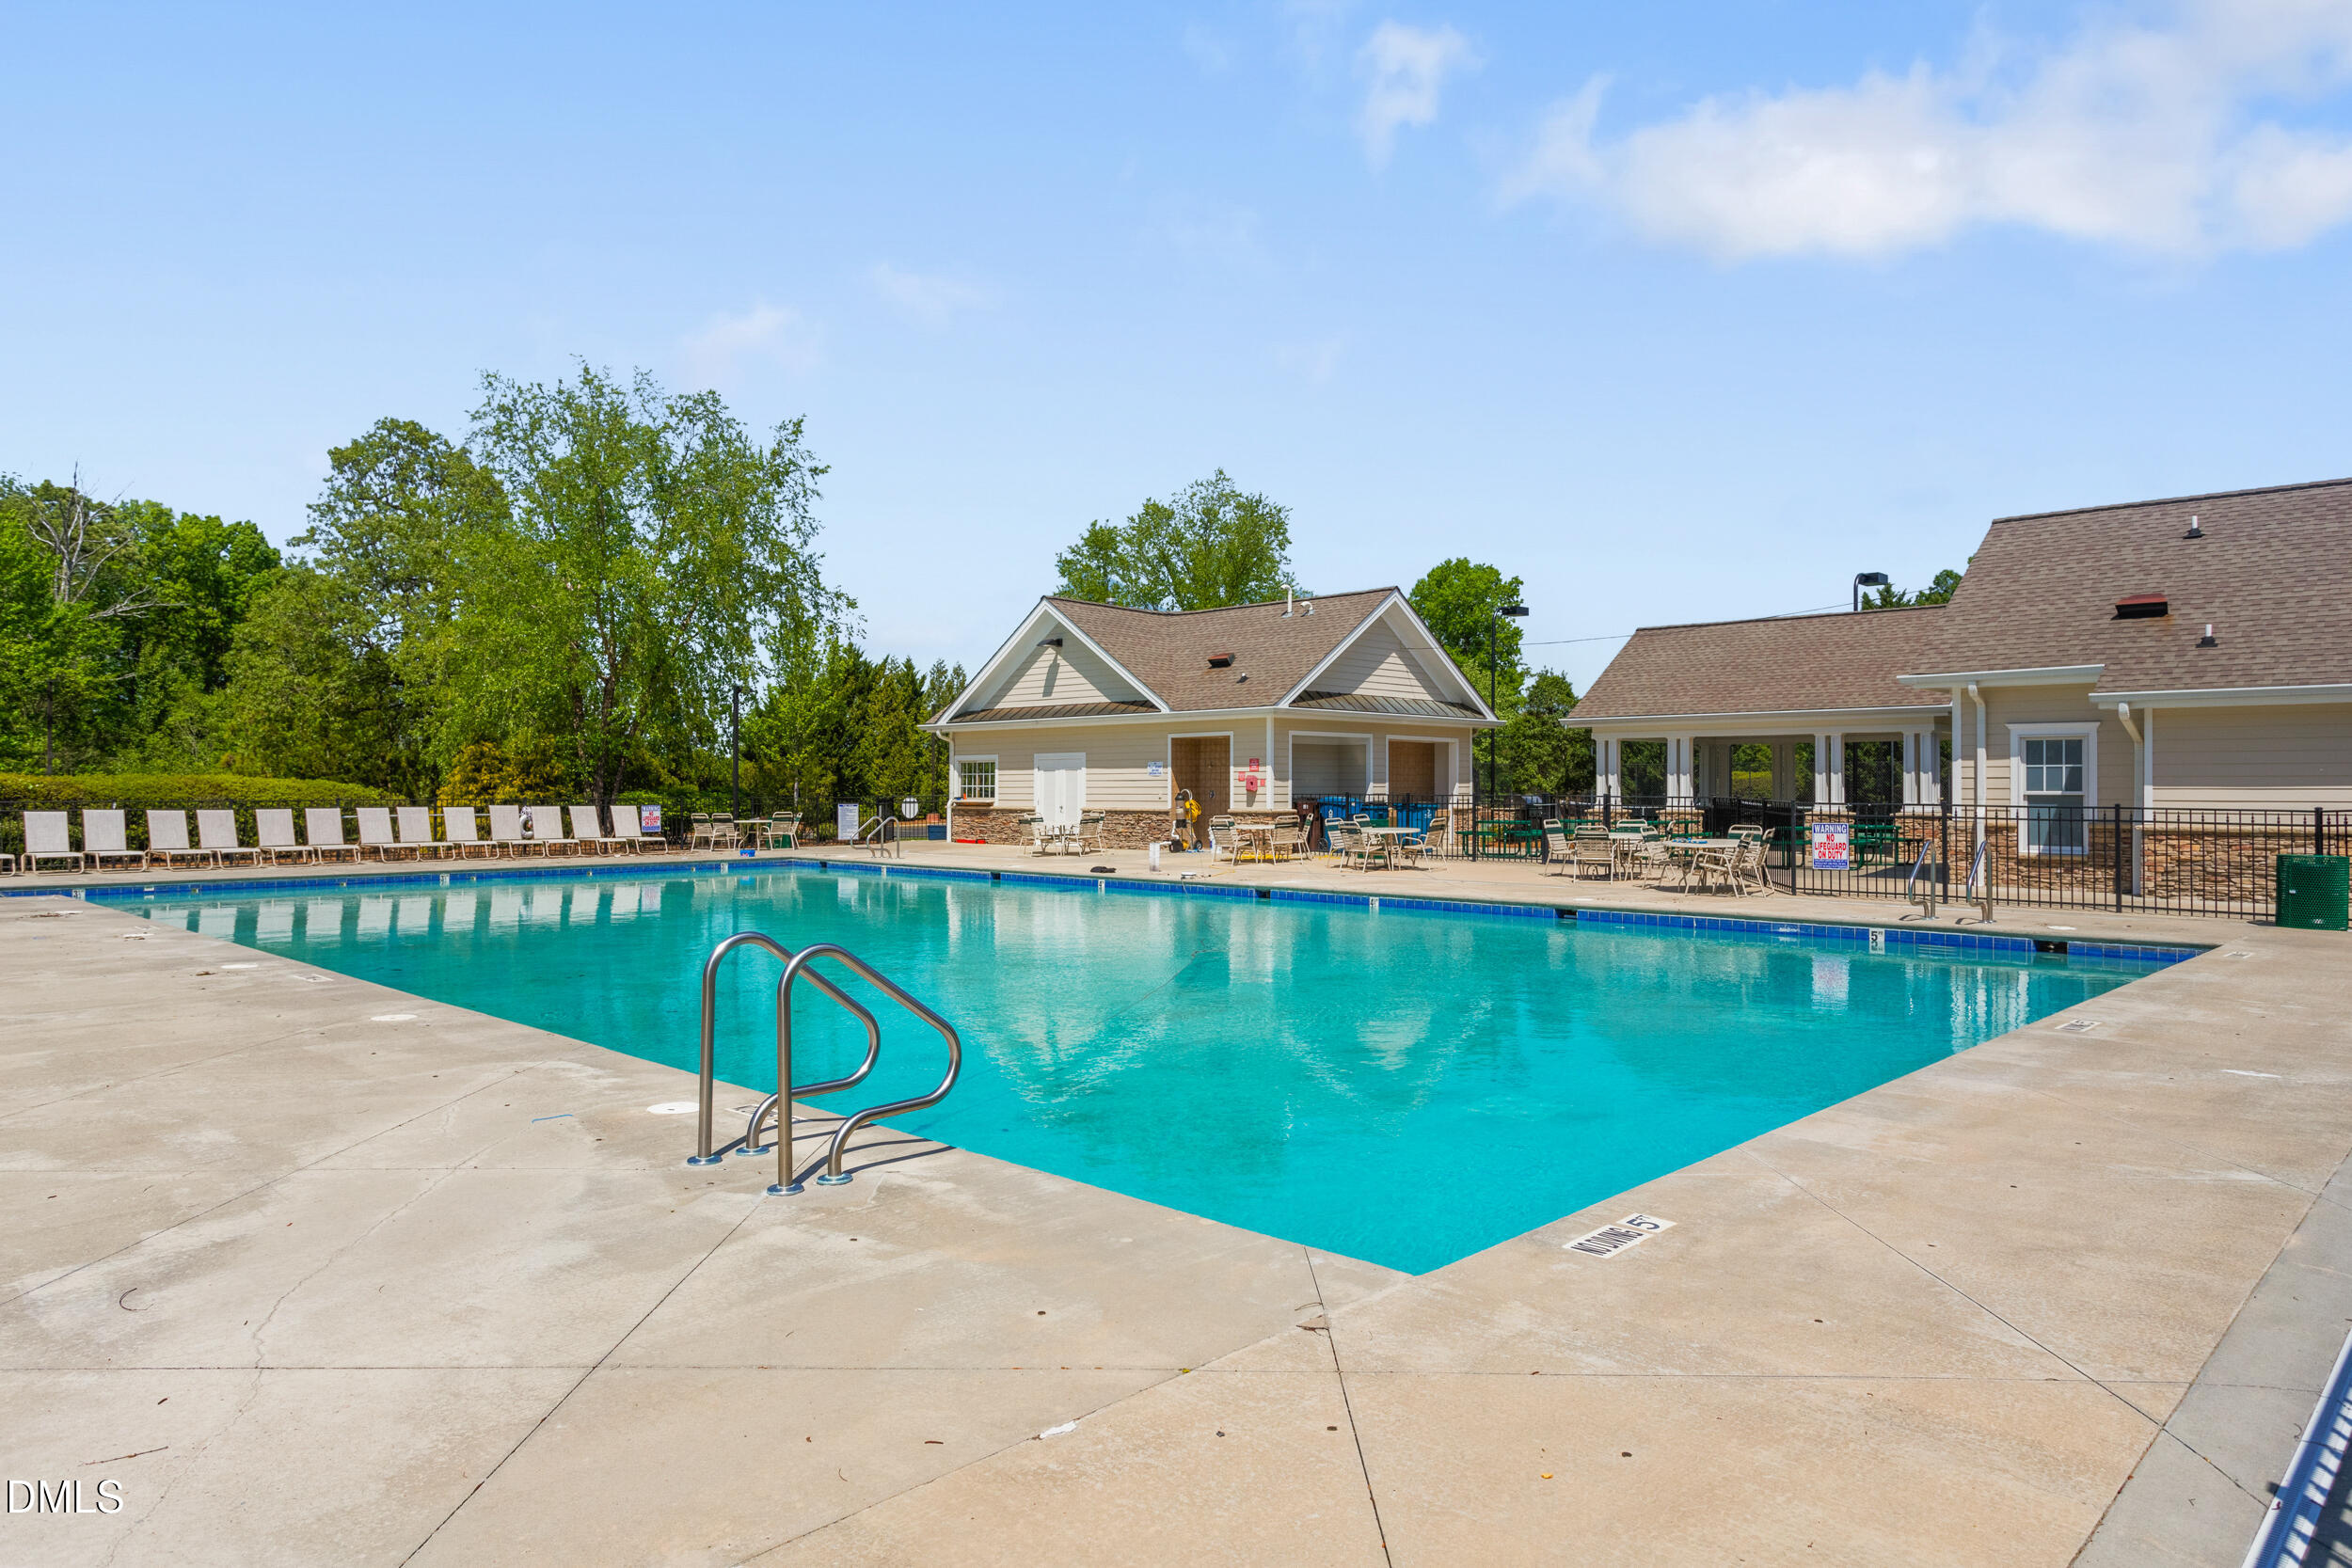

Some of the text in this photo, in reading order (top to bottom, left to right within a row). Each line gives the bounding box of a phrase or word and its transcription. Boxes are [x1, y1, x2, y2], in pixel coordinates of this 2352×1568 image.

[1814, 824, 1846, 832] WARNING
[1826, 833, 1835, 842] NO
[1815, 842, 1847, 850] LIFEGUARD
[1828, 850, 1843, 859] DUTY
[1871, 930, 1878, 942] 5
[1626, 1218, 1661, 1230] 5
[1570, 1227, 1645, 1256] NO DIVING
